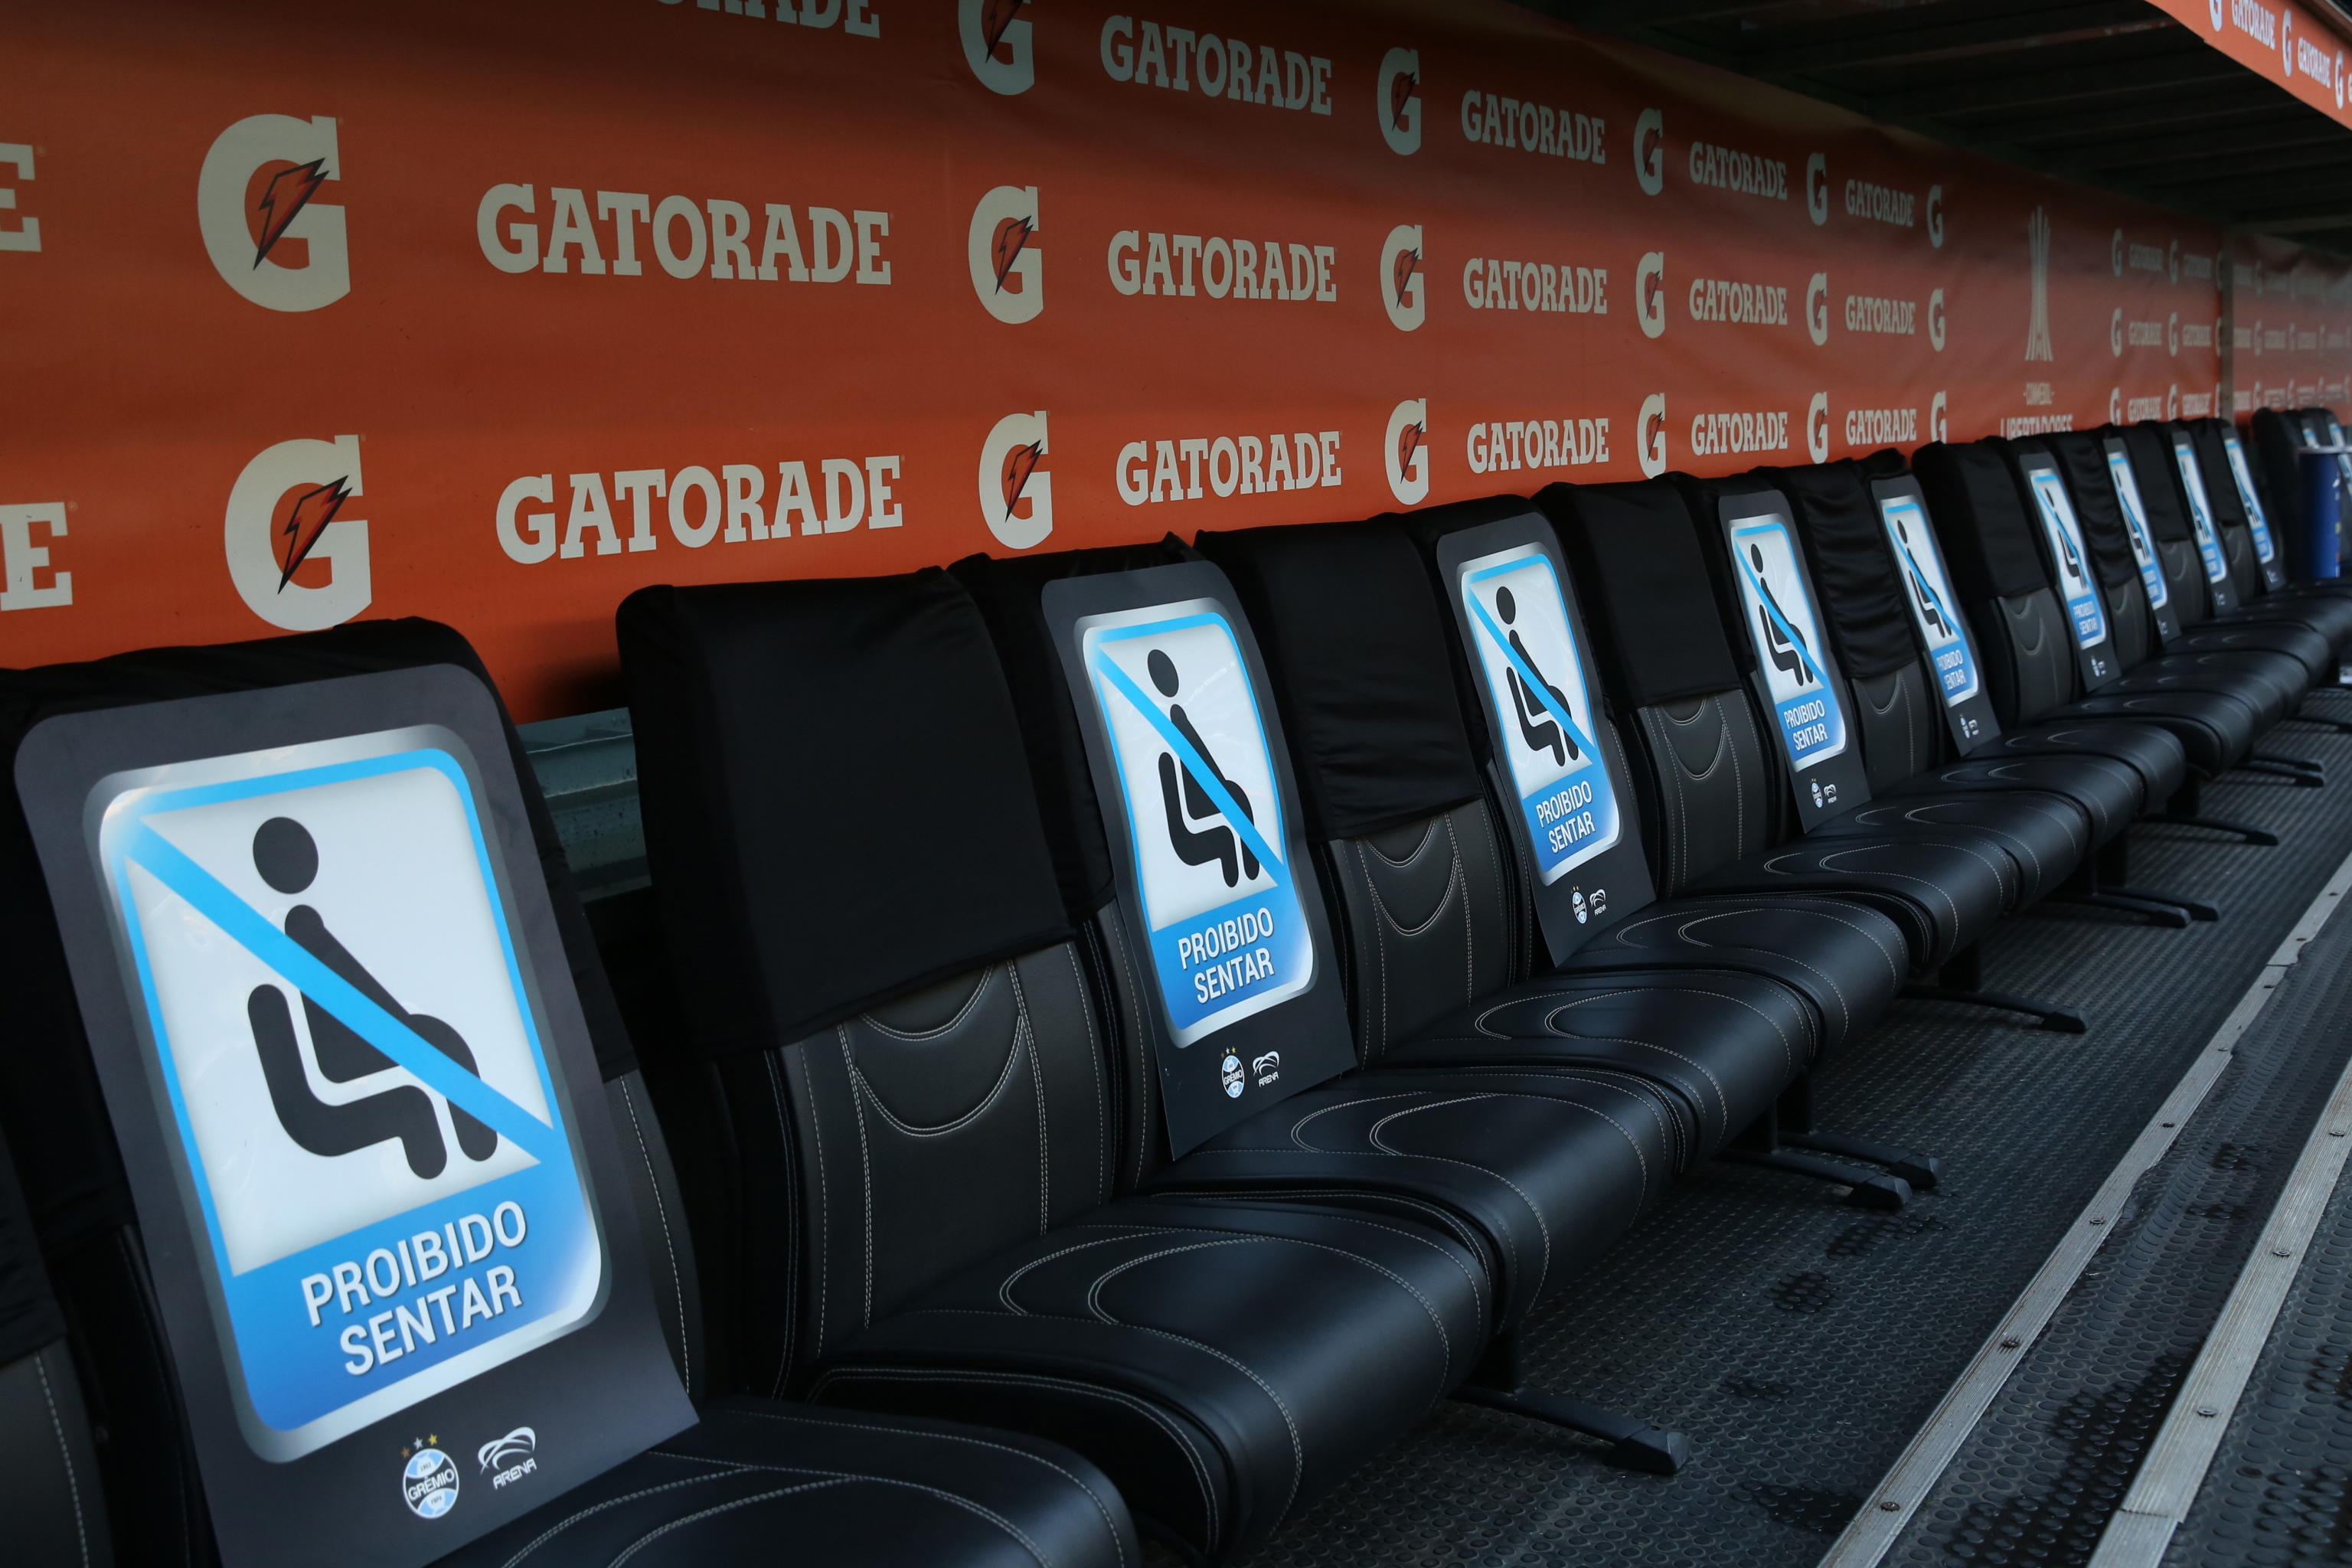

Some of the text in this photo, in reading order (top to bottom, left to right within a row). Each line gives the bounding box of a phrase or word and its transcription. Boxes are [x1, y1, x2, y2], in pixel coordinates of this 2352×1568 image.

[1100, 15, 1331, 116] GATORADE
[1378, 47, 1421, 155] G
[1461, 90, 1606, 164] GATORADE
[1633, 108, 1663, 195] G
[1689, 142, 1787, 200] GATORADE
[1807, 153, 1828, 225] G
[1846, 179, 1914, 227] GATORADE
[198, 113, 351, 312] G
[477, 184, 891, 285] GATORADE
[969, 185, 1044, 324] G
[1108, 230, 1336, 302] GATORADE
[1380, 224, 1426, 332] G
[1463, 257, 1607, 314] GATORADE
[1636, 252, 1665, 338] G
[1689, 279, 1787, 325] GATORADE
[1806, 273, 1828, 346] G
[1846, 295, 1915, 335] GATORADE
[1928, 289, 1945, 351] G
[224, 434, 372, 632] G
[496, 457, 903, 565] GATORADE
[978, 410, 1053, 549] G
[1116, 431, 1342, 505] GATORADE
[1385, 398, 1429, 505] G
[1467, 418, 1609, 474] GATORADE
[1637, 393, 1666, 479] G
[1691, 412, 1788, 456] GATORADE
[1807, 391, 1828, 464] G
[1846, 410, 1916, 446] GATORADE
[1783, 699, 1825, 729] PROIBIDO
[1792, 723, 1828, 751] SENTAR
[1536, 780, 1592, 828] PROIBIDO
[1548, 811, 1596, 853] SENTAR
[1178, 907, 1274, 970] PROIBIDO
[1194, 947, 1275, 1004] SENTAR
[301, 1200, 528, 1328] PROIBIDO
[340, 1265, 523, 1376] SENTAR
[407, 1468, 456, 1502] GRÊMIO
[492, 1458, 537, 1490] ARENA
